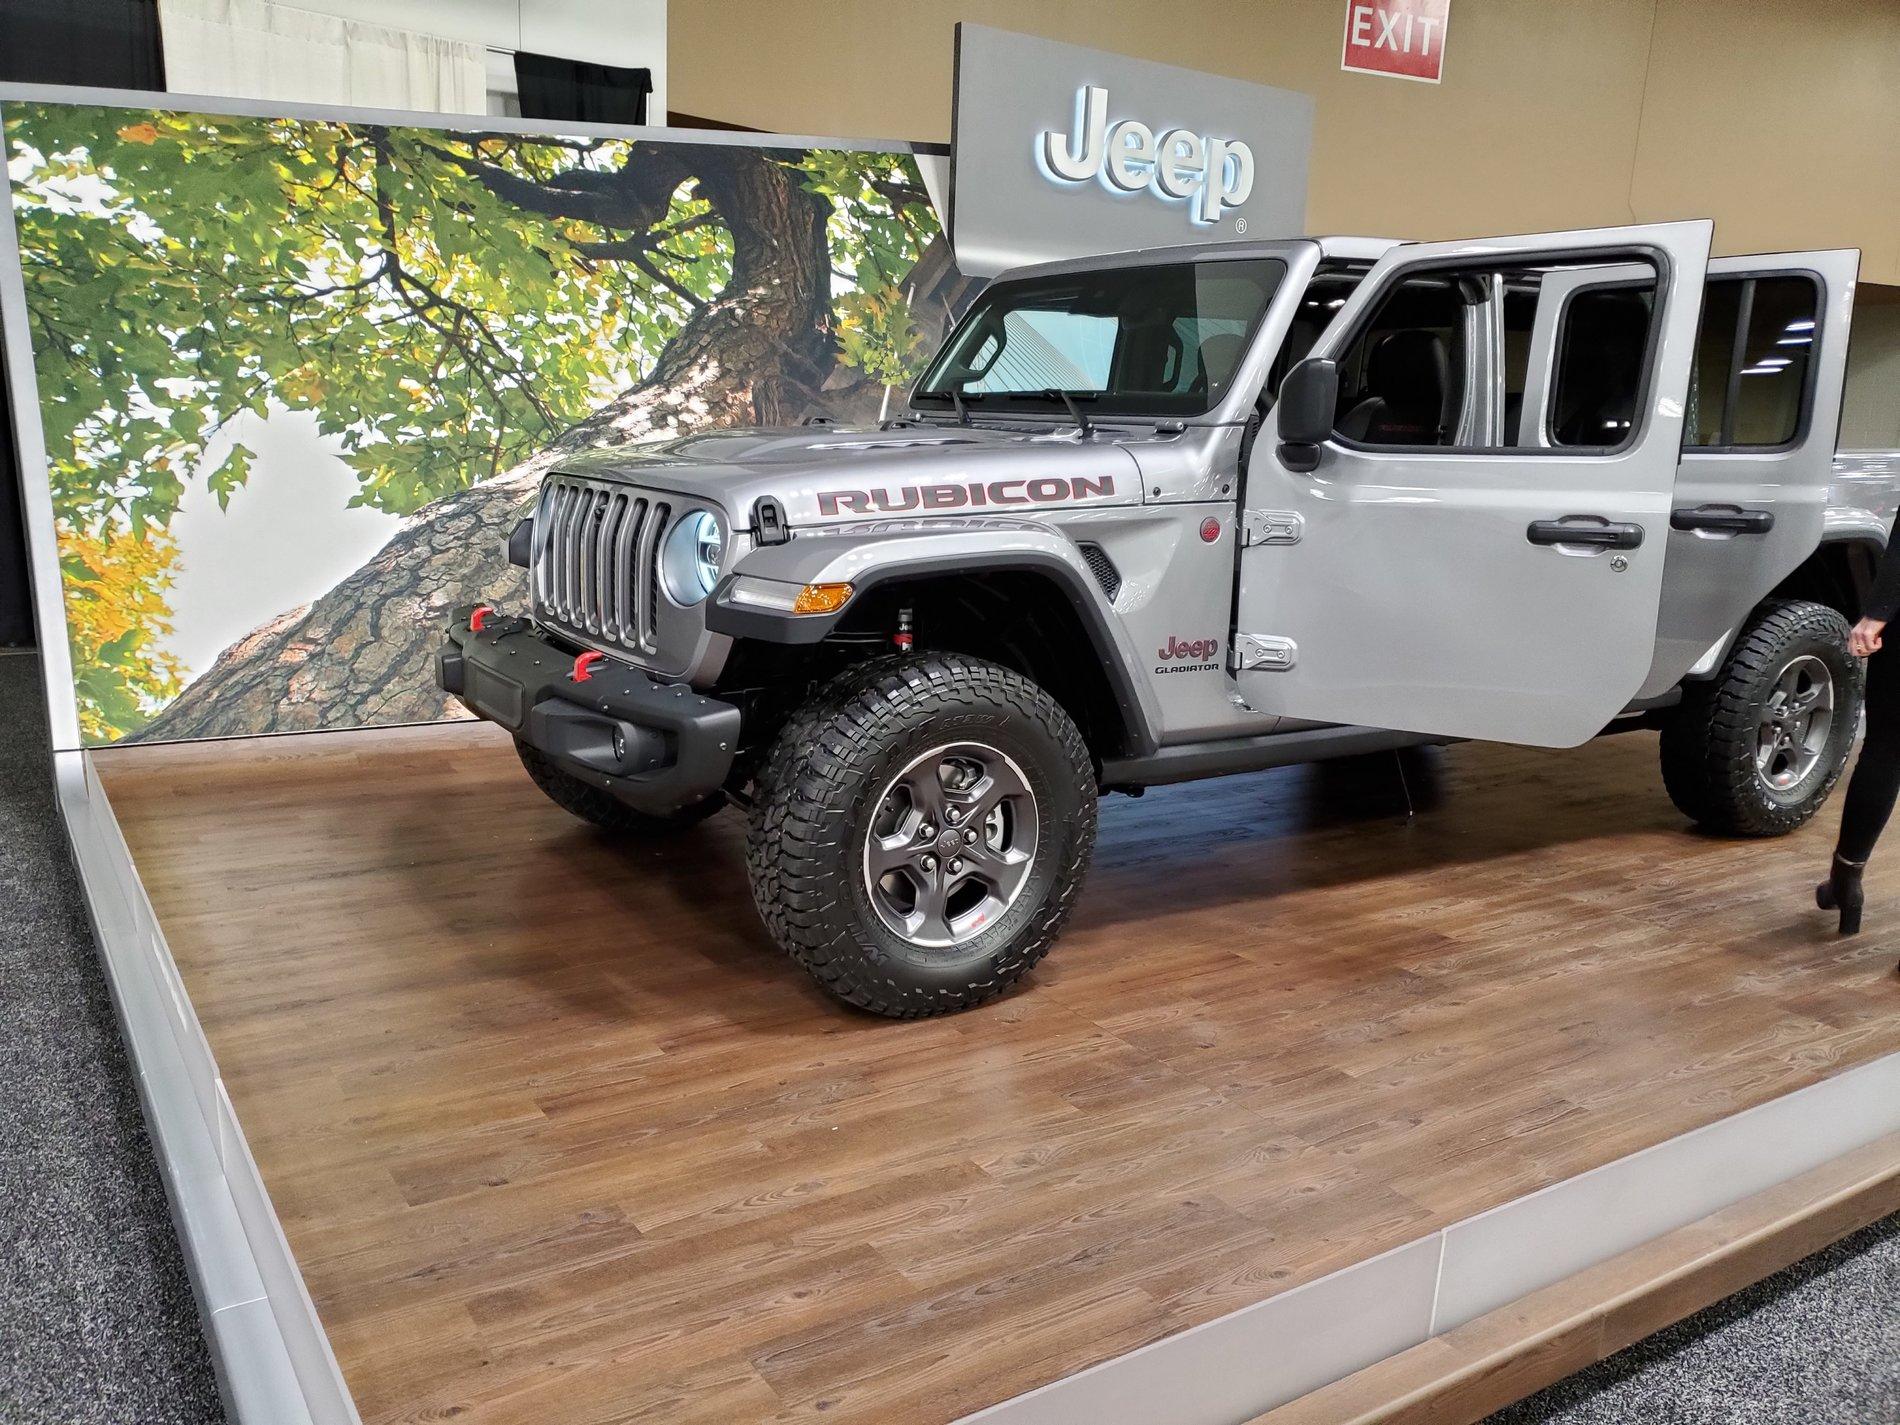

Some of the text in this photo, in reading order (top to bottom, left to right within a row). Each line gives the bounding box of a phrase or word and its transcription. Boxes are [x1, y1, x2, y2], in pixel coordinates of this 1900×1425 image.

[1352, 6, 1440, 55] EXIT
[1042, 85, 1255, 223] Jeep
[817, 475, 1115, 515] RUBICON
[1155, 663, 1218, 674] GLADIATOR
[1158, 636, 1218, 661] Jeep
